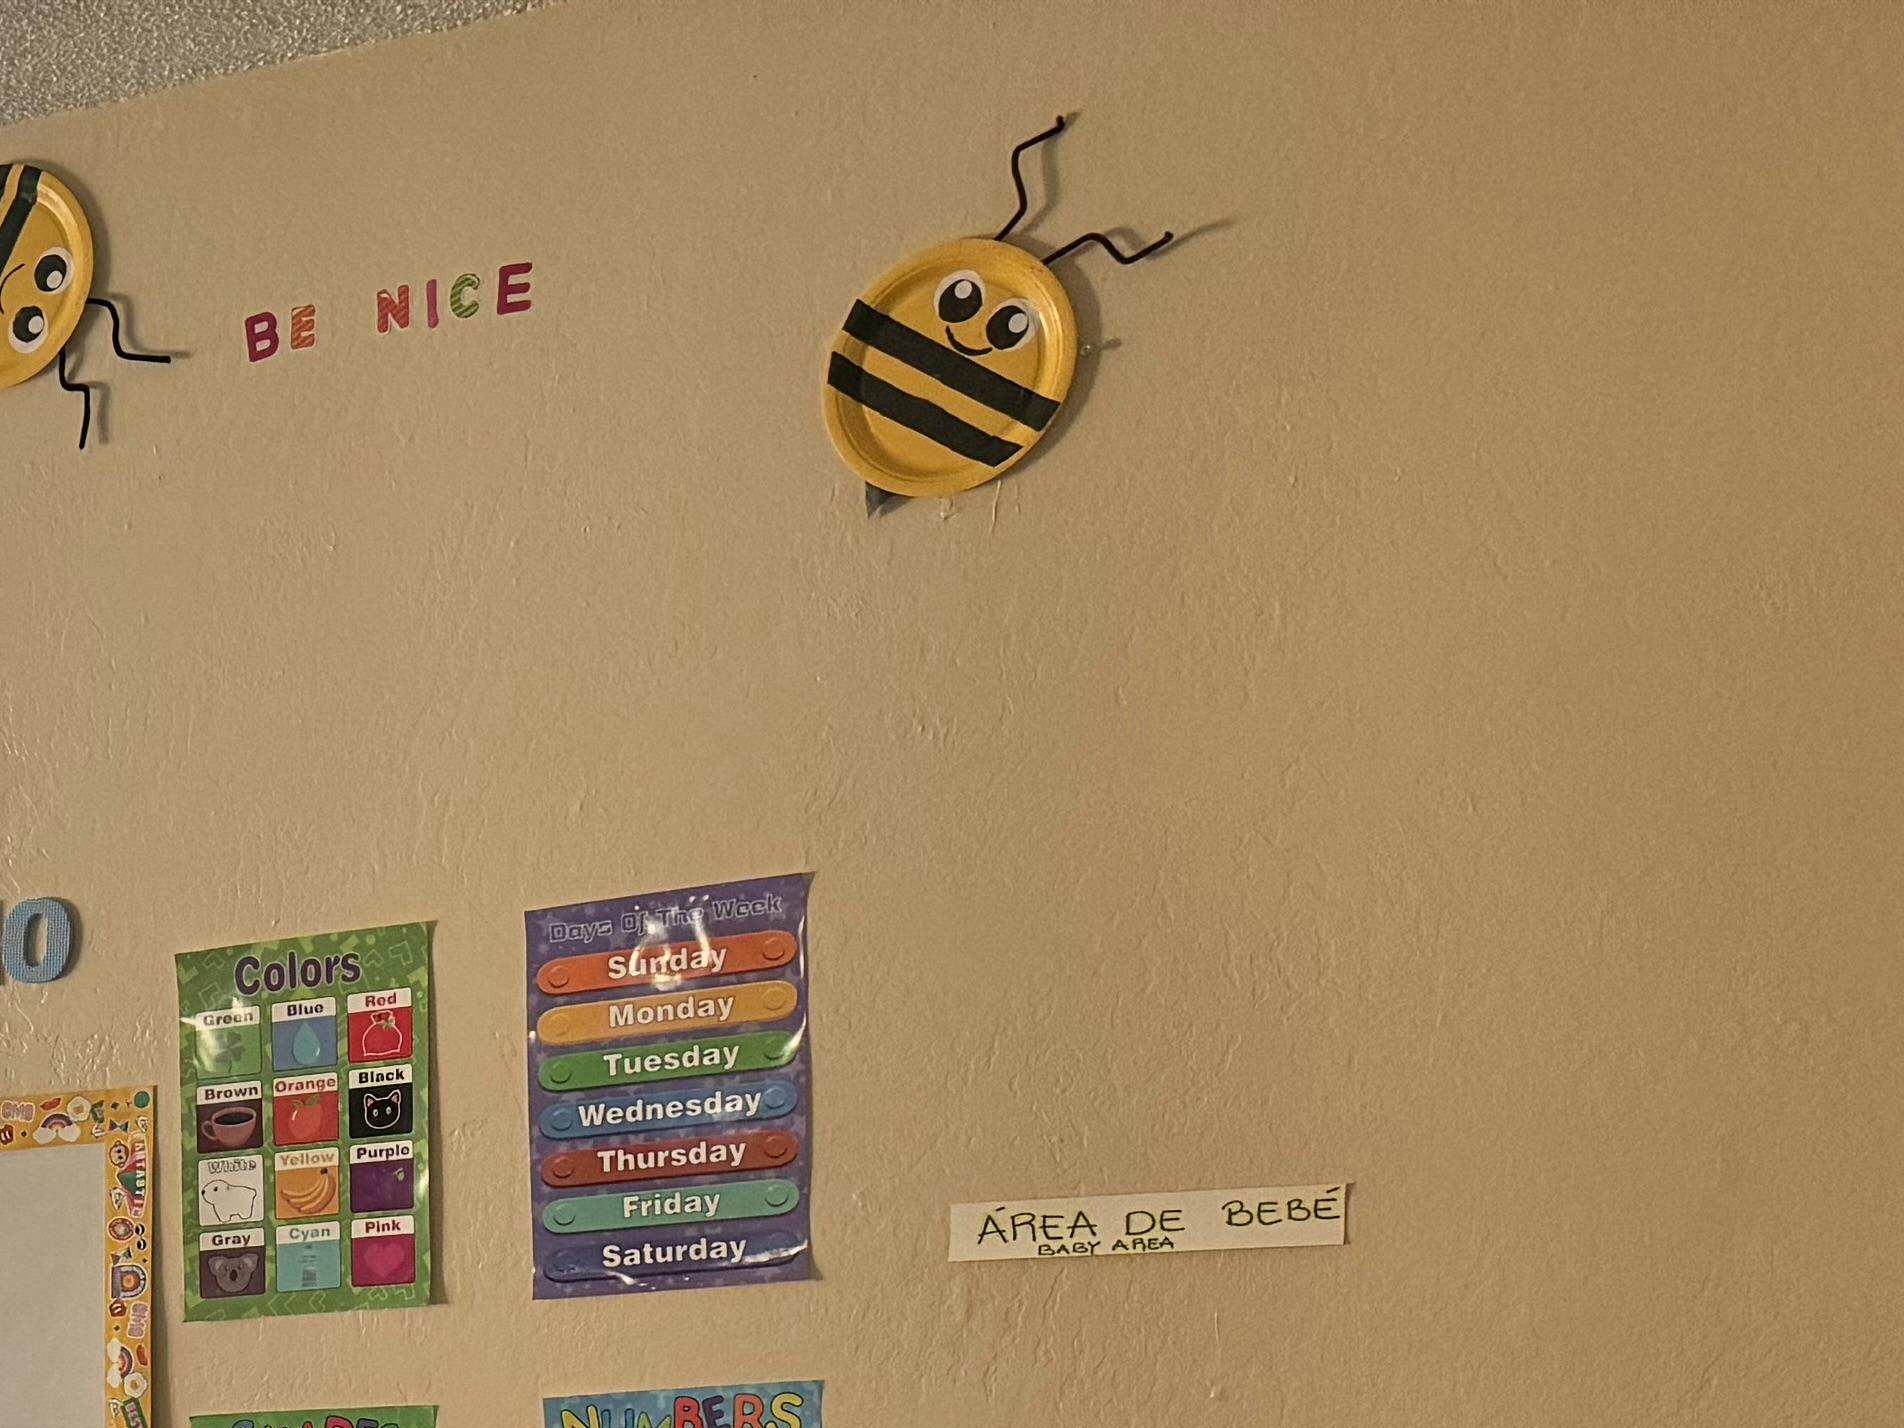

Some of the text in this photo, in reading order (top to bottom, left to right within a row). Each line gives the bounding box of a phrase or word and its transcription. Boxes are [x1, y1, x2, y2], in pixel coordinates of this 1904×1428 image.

[244, 262, 533, 362] BE NICE
[549, 920, 613, 942] Days
[657, 907, 704, 928] The
[712, 894, 782, 920] Week
[608, 948, 726, 980] Sunday
[235, 951, 361, 996] Colors
[365, 993, 397, 1007] Red
[203, 1010, 254, 1026] Green
[286, 1002, 324, 1017] Blue
[609, 996, 735, 1028] Monday
[603, 1043, 741, 1077] Tuesday
[359, 1069, 404, 1083] Black
[205, 1085, 259, 1101] Brown
[275, 1077, 336, 1093] Orange
[578, 1091, 762, 1127] Wednesday
[280, 1151, 334, 1166] Yellow
[357, 1144, 410, 1160] Purple
[597, 1141, 746, 1173] Thursday
[207, 1158, 257, 1174] White
[623, 1190, 721, 1218] Friday
[978, 1187, 1341, 1243] ÁREA DE BEBÉ
[289, 1226, 330, 1241] Cyan
[365, 1220, 401, 1234] Pink
[212, 1232, 251, 1248] Gray
[1038, 1237, 1173, 1256] BABY AREA
[602, 1238, 746, 1268] Saturday
